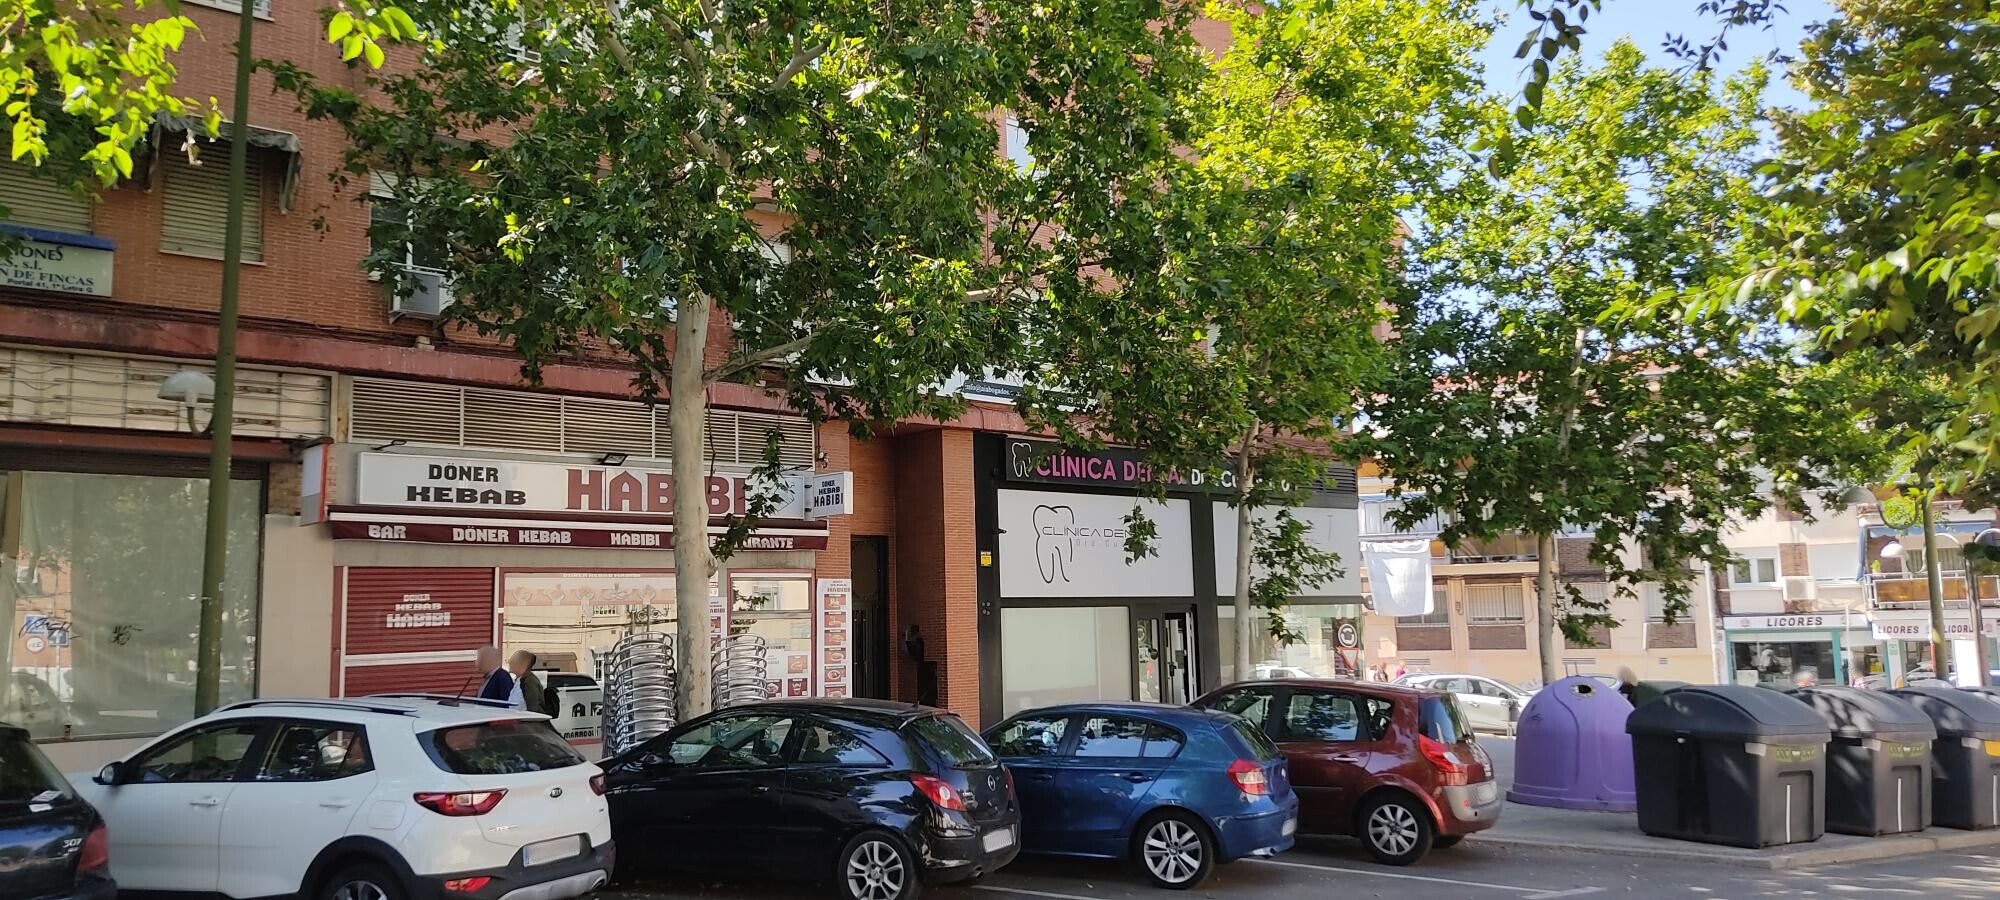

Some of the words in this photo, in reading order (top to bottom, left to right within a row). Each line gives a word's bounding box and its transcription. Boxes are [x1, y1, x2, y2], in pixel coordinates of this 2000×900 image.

[14, 270, 34, 281] DE
[40, 272, 94, 286] FINCAS
[1037, 449, 1117, 481] CLÍNICA
[406, 485, 526, 505] KEBAB
[428, 463, 498, 482] DÖNER
[566, 468, 746, 515] HABBI
[818, 487, 840, 495] KEBAB
[814, 493, 843, 507] HABIBI
[368, 525, 406, 539] BAR
[453, 526, 509, 542] DÖNER
[518, 530, 572, 544] KEBAB
[610, 533, 660, 546] HABIBI
[1042, 526, 1101, 537] CLINICA
[386, 612, 451, 628] HABIBI
[1767, 616, 1823, 627] LICORES
[63, 838, 83, 848] 307
